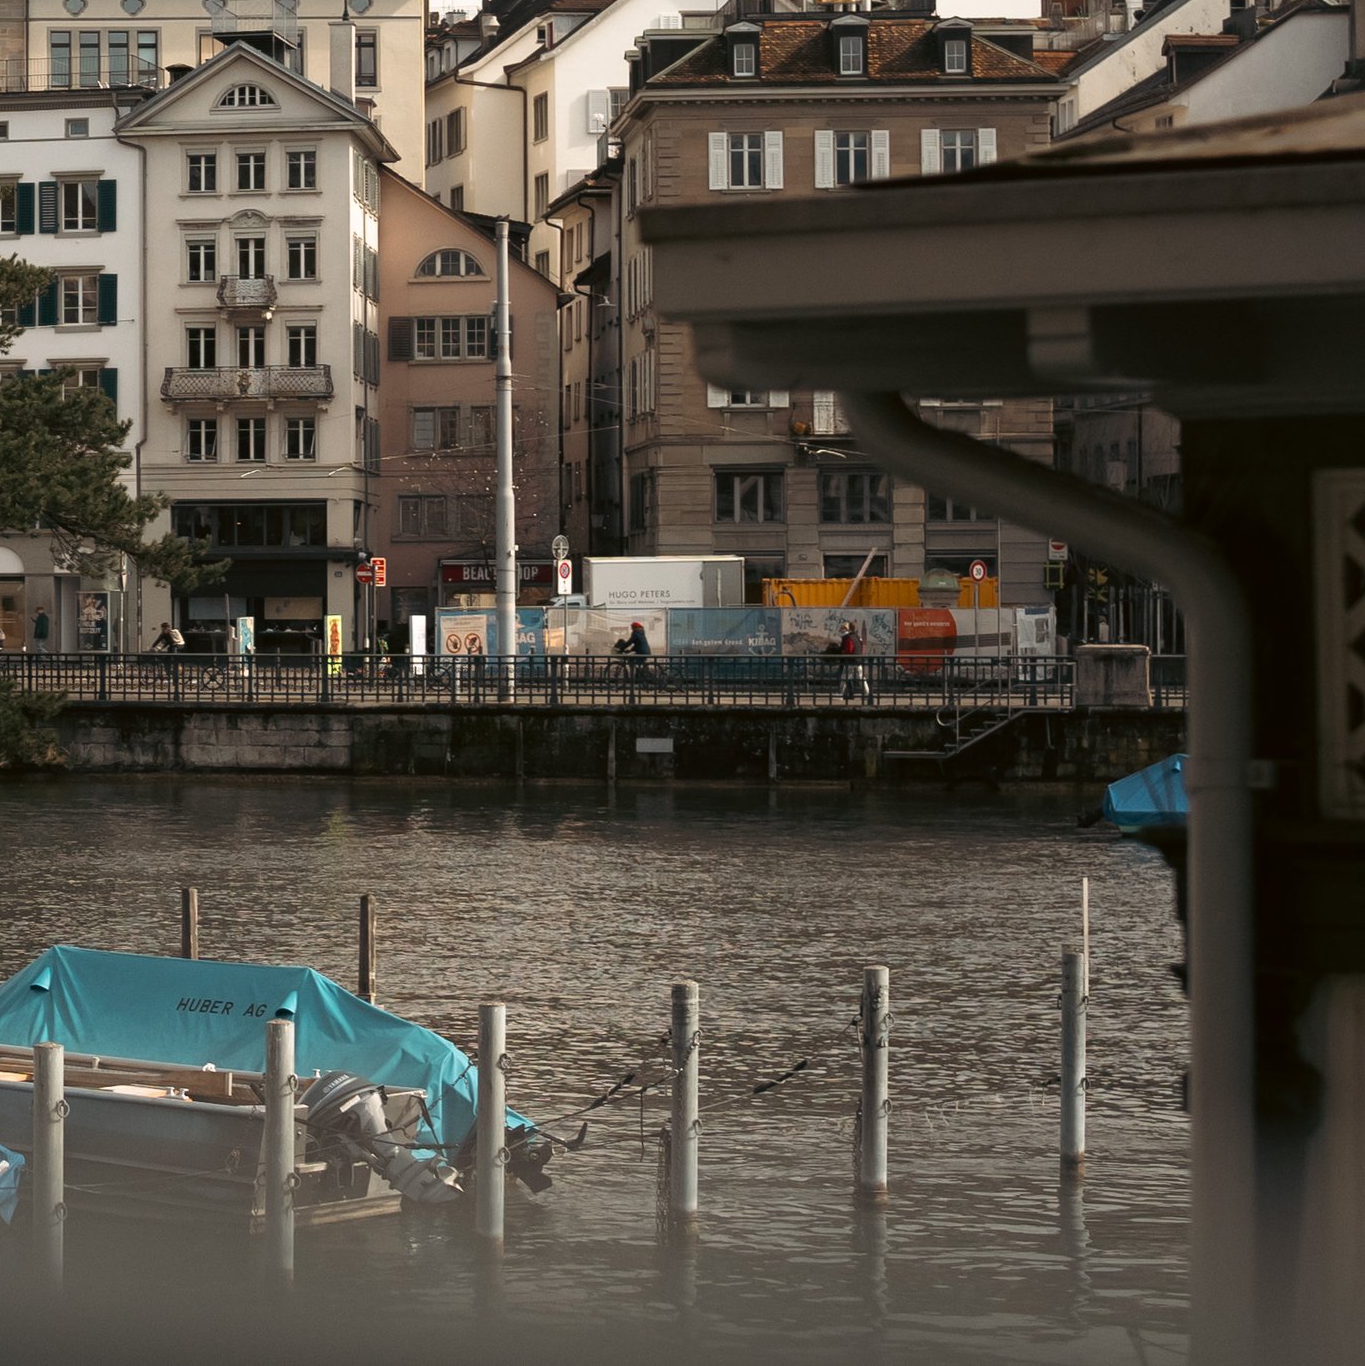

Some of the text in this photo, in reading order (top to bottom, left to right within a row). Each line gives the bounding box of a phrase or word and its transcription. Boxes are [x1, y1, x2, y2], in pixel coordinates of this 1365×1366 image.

[462, 566, 497, 580] BEAUT
[609, 589, 671, 599] HUGO PETERS
[749, 636, 776, 646] KIBAG
[176, 997, 268, 1017] HUBER AG
[328, 1074, 350, 1089] YAMAHA
